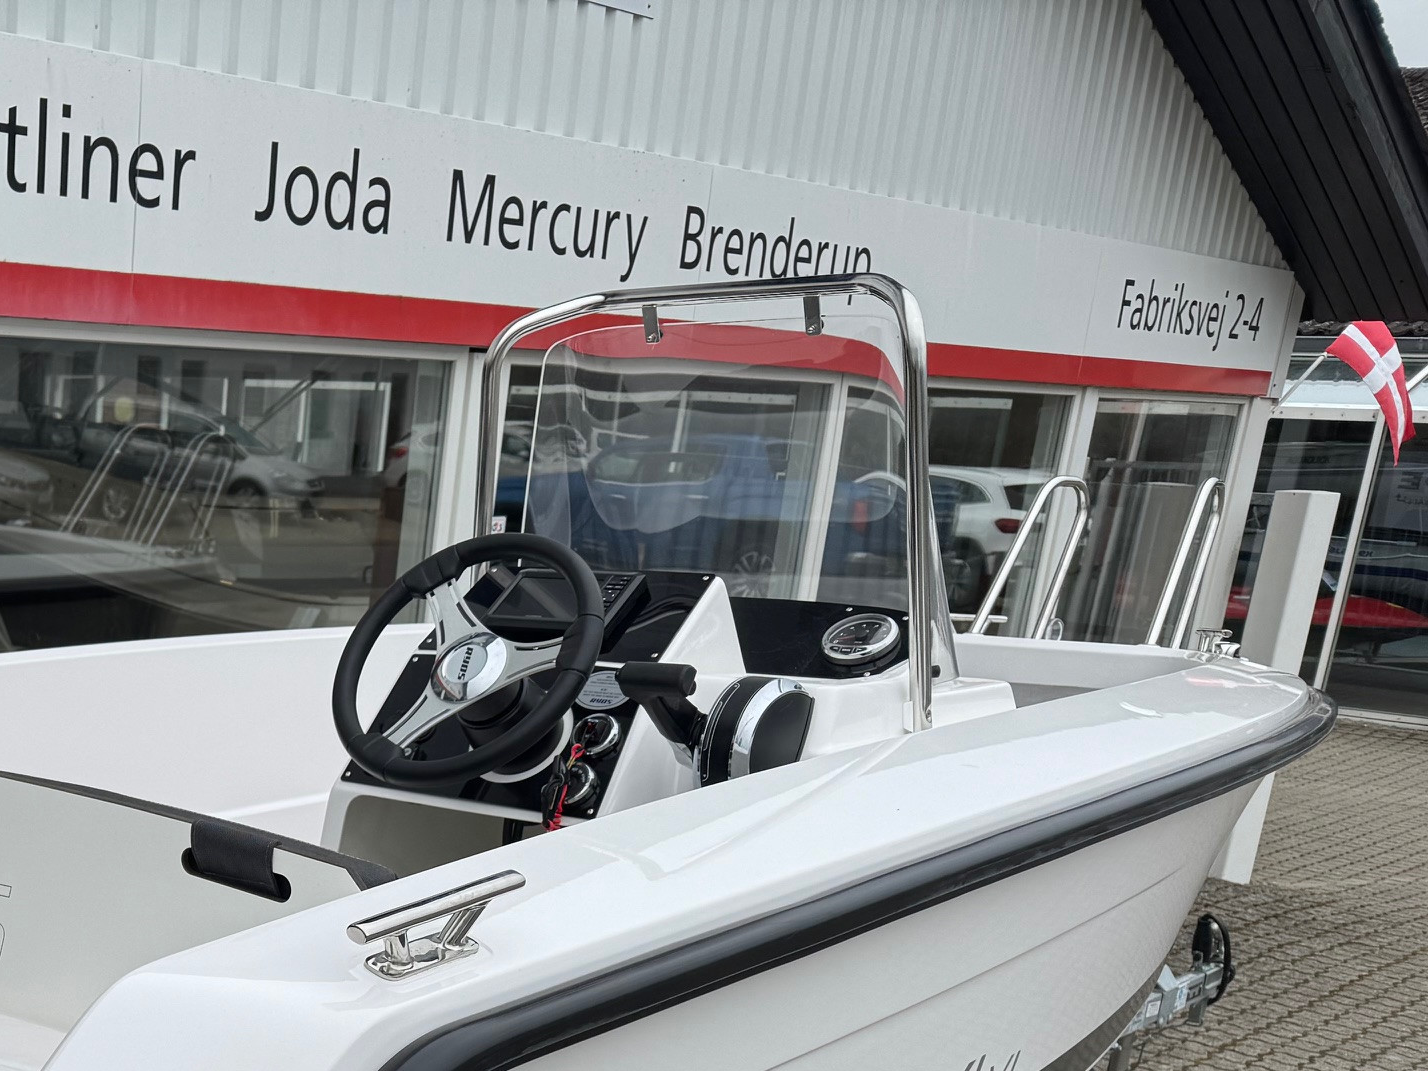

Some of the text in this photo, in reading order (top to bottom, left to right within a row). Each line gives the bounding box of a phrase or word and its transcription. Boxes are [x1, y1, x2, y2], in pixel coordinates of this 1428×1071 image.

[254, 141, 392, 235] Joda
[446, 168, 649, 283] Mercury
[1117, 278, 1265, 352] Fabriksvej 2-4
